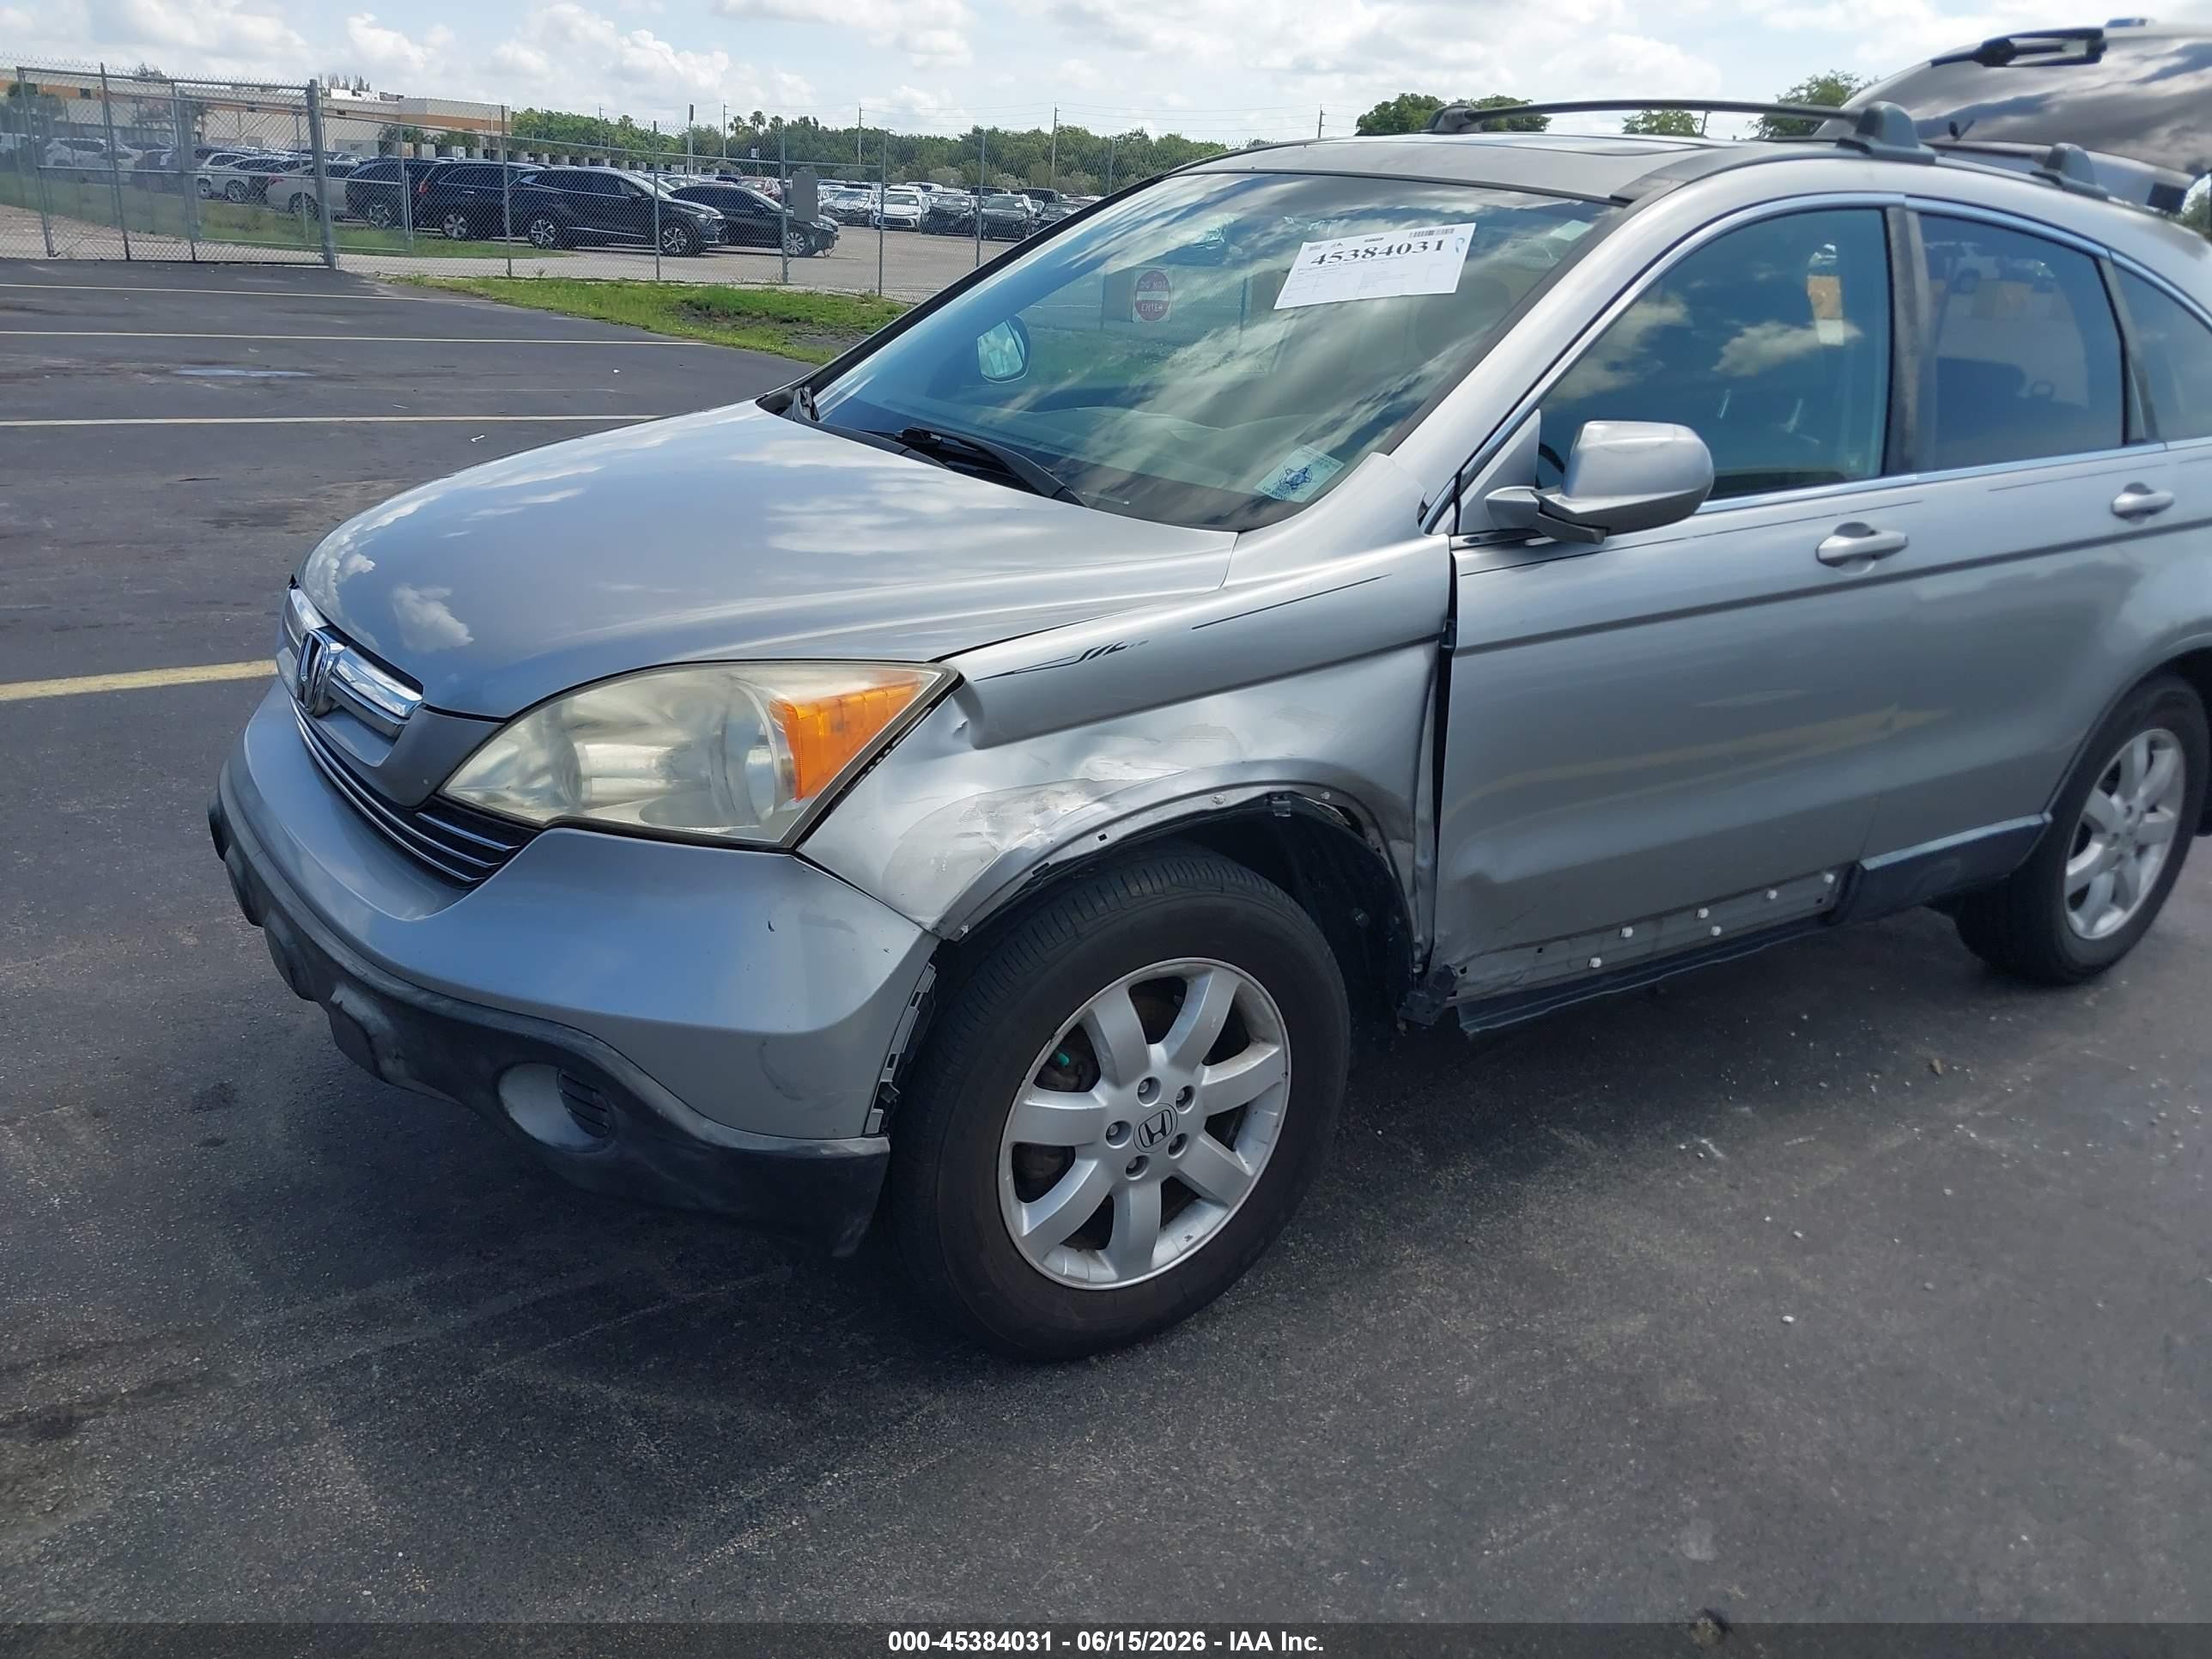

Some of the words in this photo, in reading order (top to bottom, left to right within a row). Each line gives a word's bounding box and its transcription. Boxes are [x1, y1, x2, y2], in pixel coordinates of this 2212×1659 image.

[1310, 239, 1445, 265] 45384031
[1140, 281, 1151, 289] DO
[1152, 281, 1167, 289] NOT
[1141, 303, 1163, 312] ENTER
